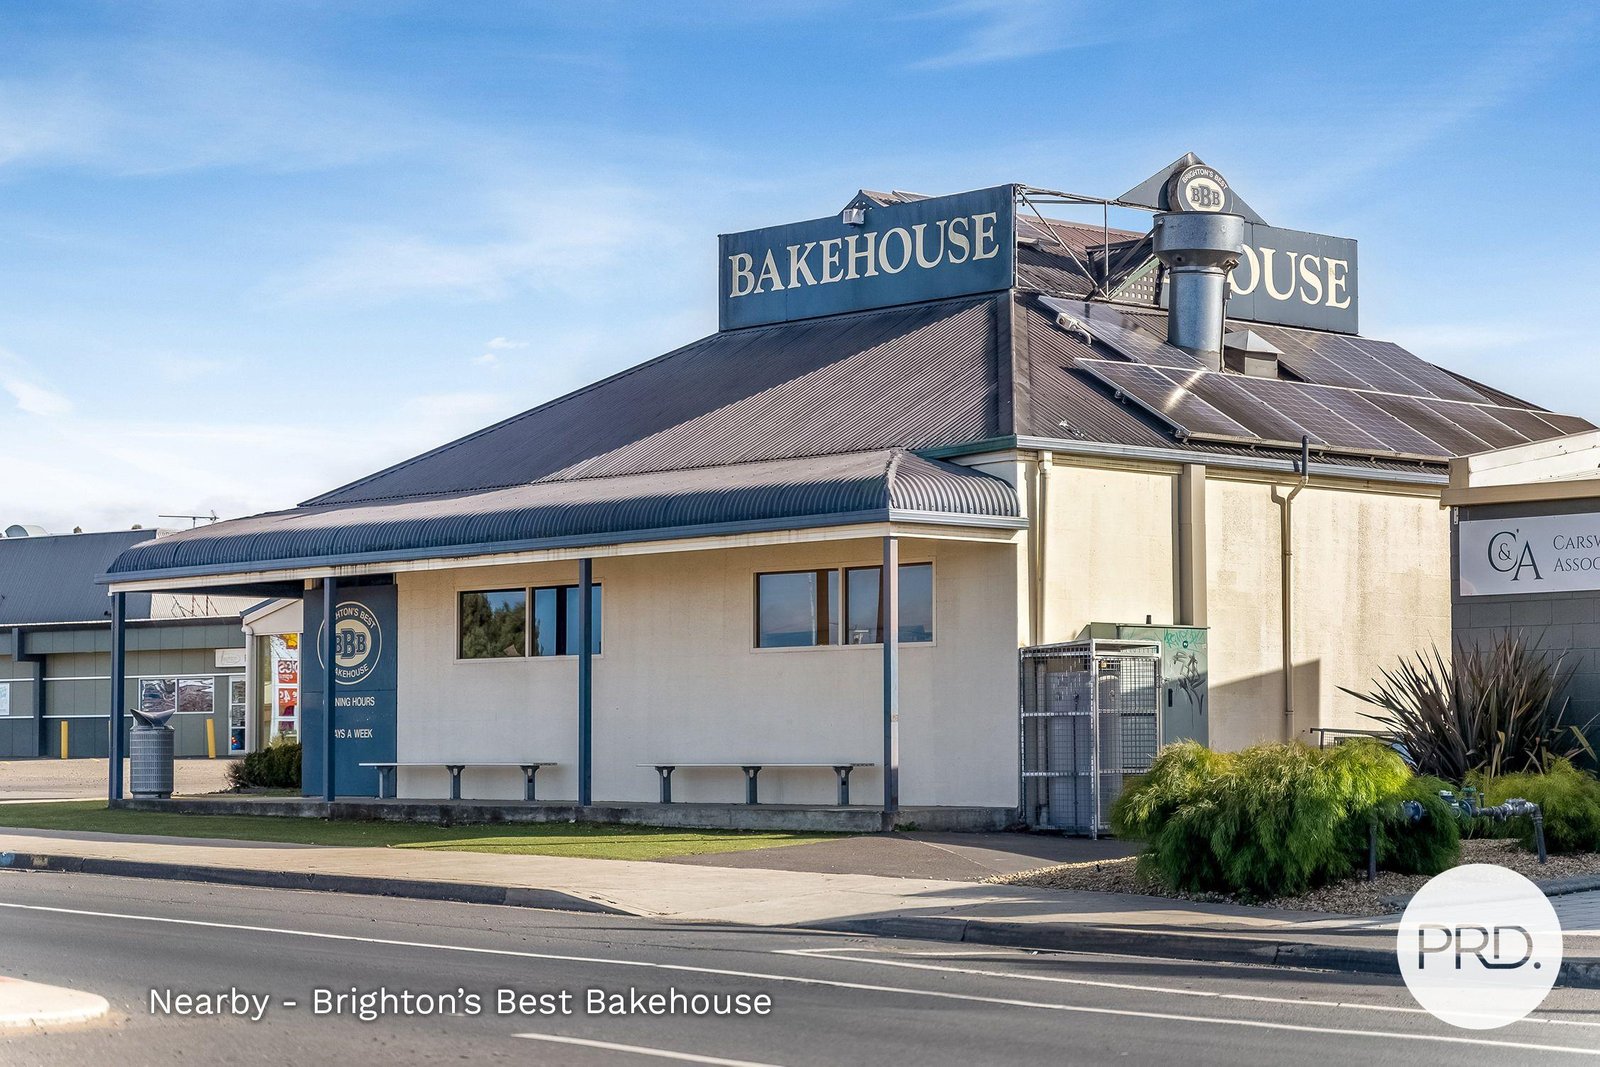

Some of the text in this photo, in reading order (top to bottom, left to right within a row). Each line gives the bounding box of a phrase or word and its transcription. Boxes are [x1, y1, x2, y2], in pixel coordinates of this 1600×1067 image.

[1181, 168, 1228, 189] BRIGHTON'S BEST
[1190, 183, 1221, 208] BBB
[727, 211, 1000, 299] BAKEHOUSE
[1227, 243, 1352, 310] OUSE
[335, 607, 376, 629] HTON'S BEST
[335, 663, 369, 678] AKEHOUSE
[335, 696, 376, 707] NING HOURS
[335, 728, 373, 739] AYS A WEEK
